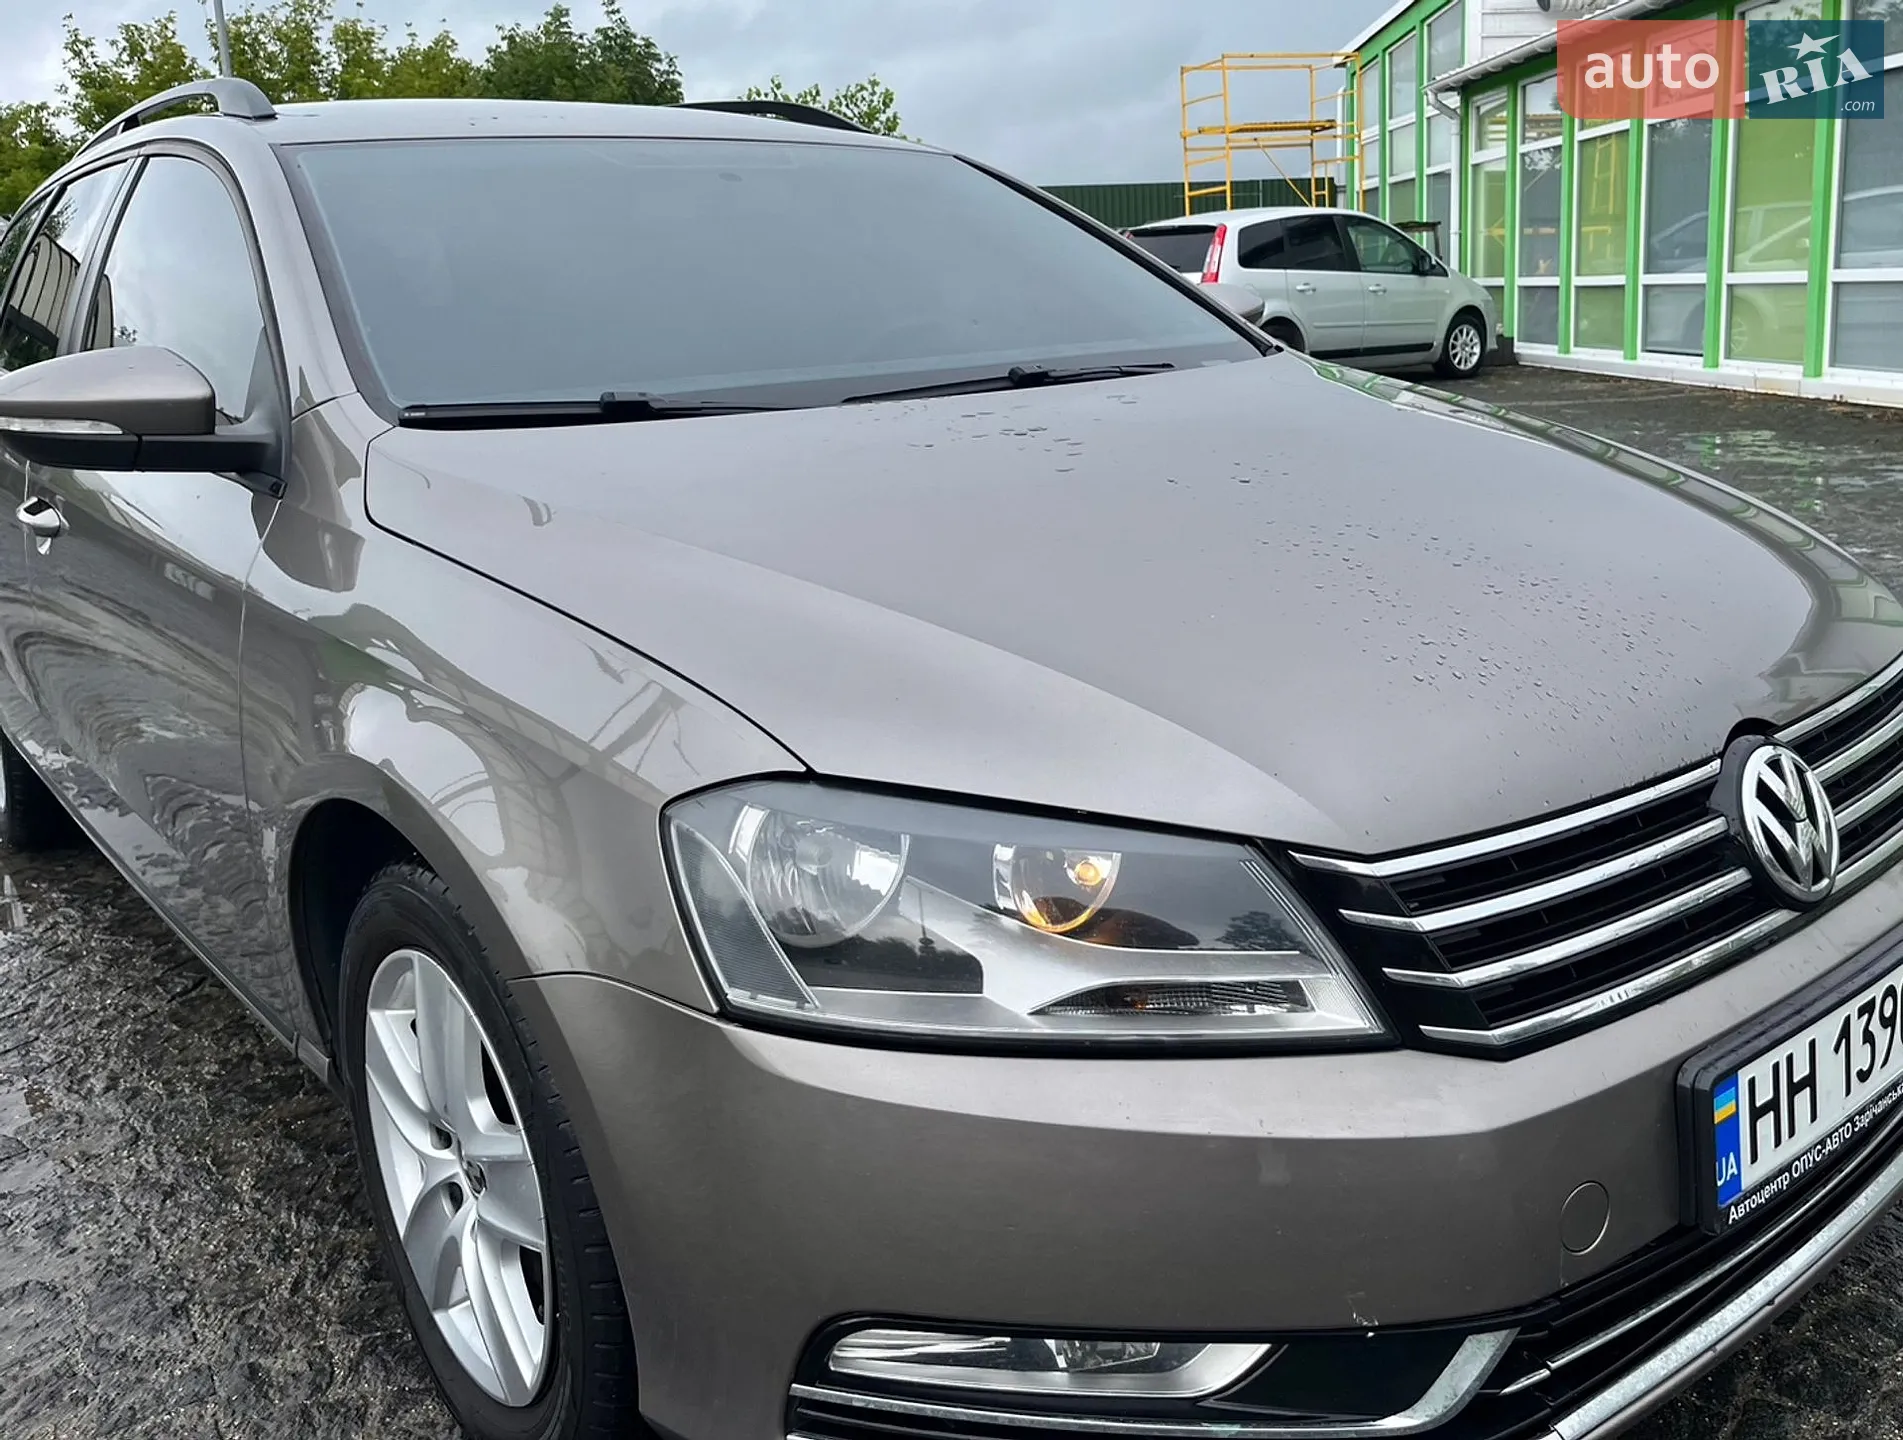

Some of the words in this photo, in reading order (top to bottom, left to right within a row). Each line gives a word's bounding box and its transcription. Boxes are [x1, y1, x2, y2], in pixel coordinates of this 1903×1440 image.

[1746, 1037, 1818, 1166] HH
[1833, 983, 1903, 1098] 139
[1716, 1151, 1738, 1187] UA
[1728, 1171, 1790, 1224] Автоцентр
[1792, 1121, 1853, 1178] ОПУС-АВТО
[1853, 1082, 1903, 1132] Зарічанськ
